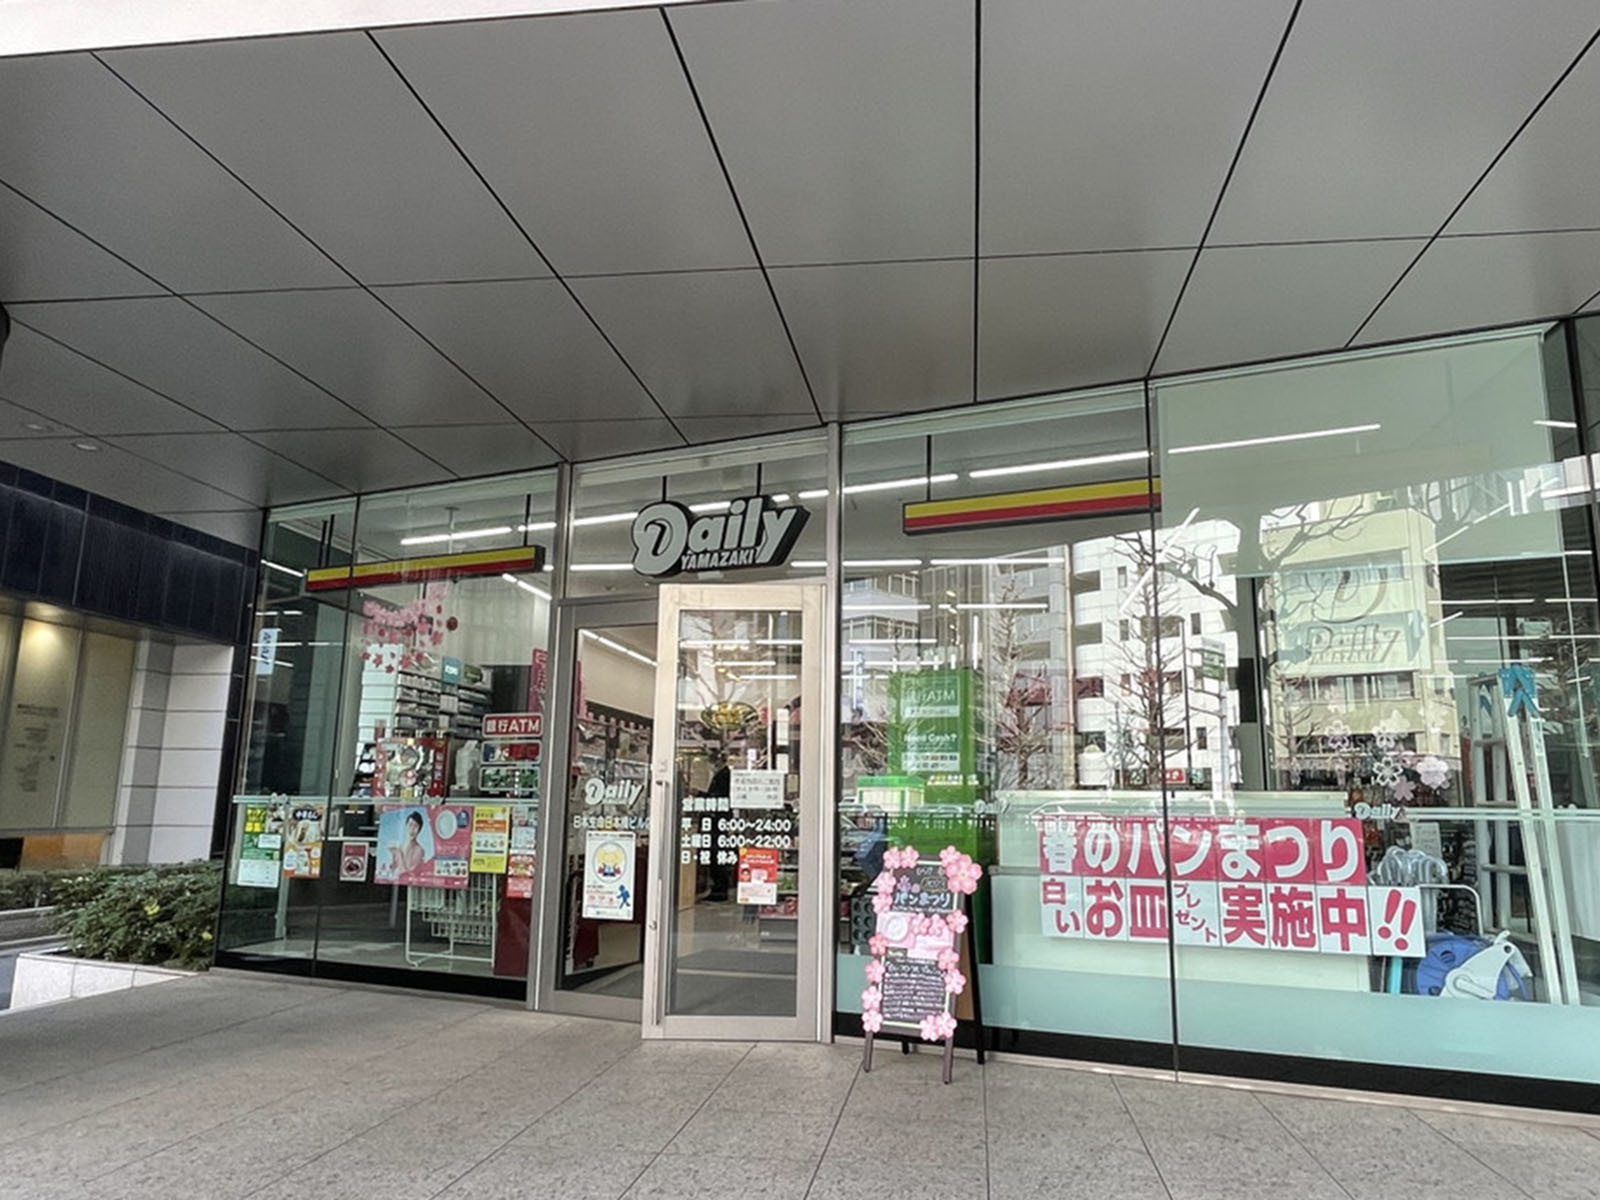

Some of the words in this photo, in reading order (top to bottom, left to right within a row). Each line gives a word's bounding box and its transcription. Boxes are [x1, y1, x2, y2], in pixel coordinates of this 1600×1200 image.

[633, 499, 797, 576] Daily
[681, 549, 754, 570] YAMAZAKI
[585, 777, 644, 809] Daily
[681, 835, 712, 848] 土曜日
[1043, 815, 1359, 883] 春のパンまつり
